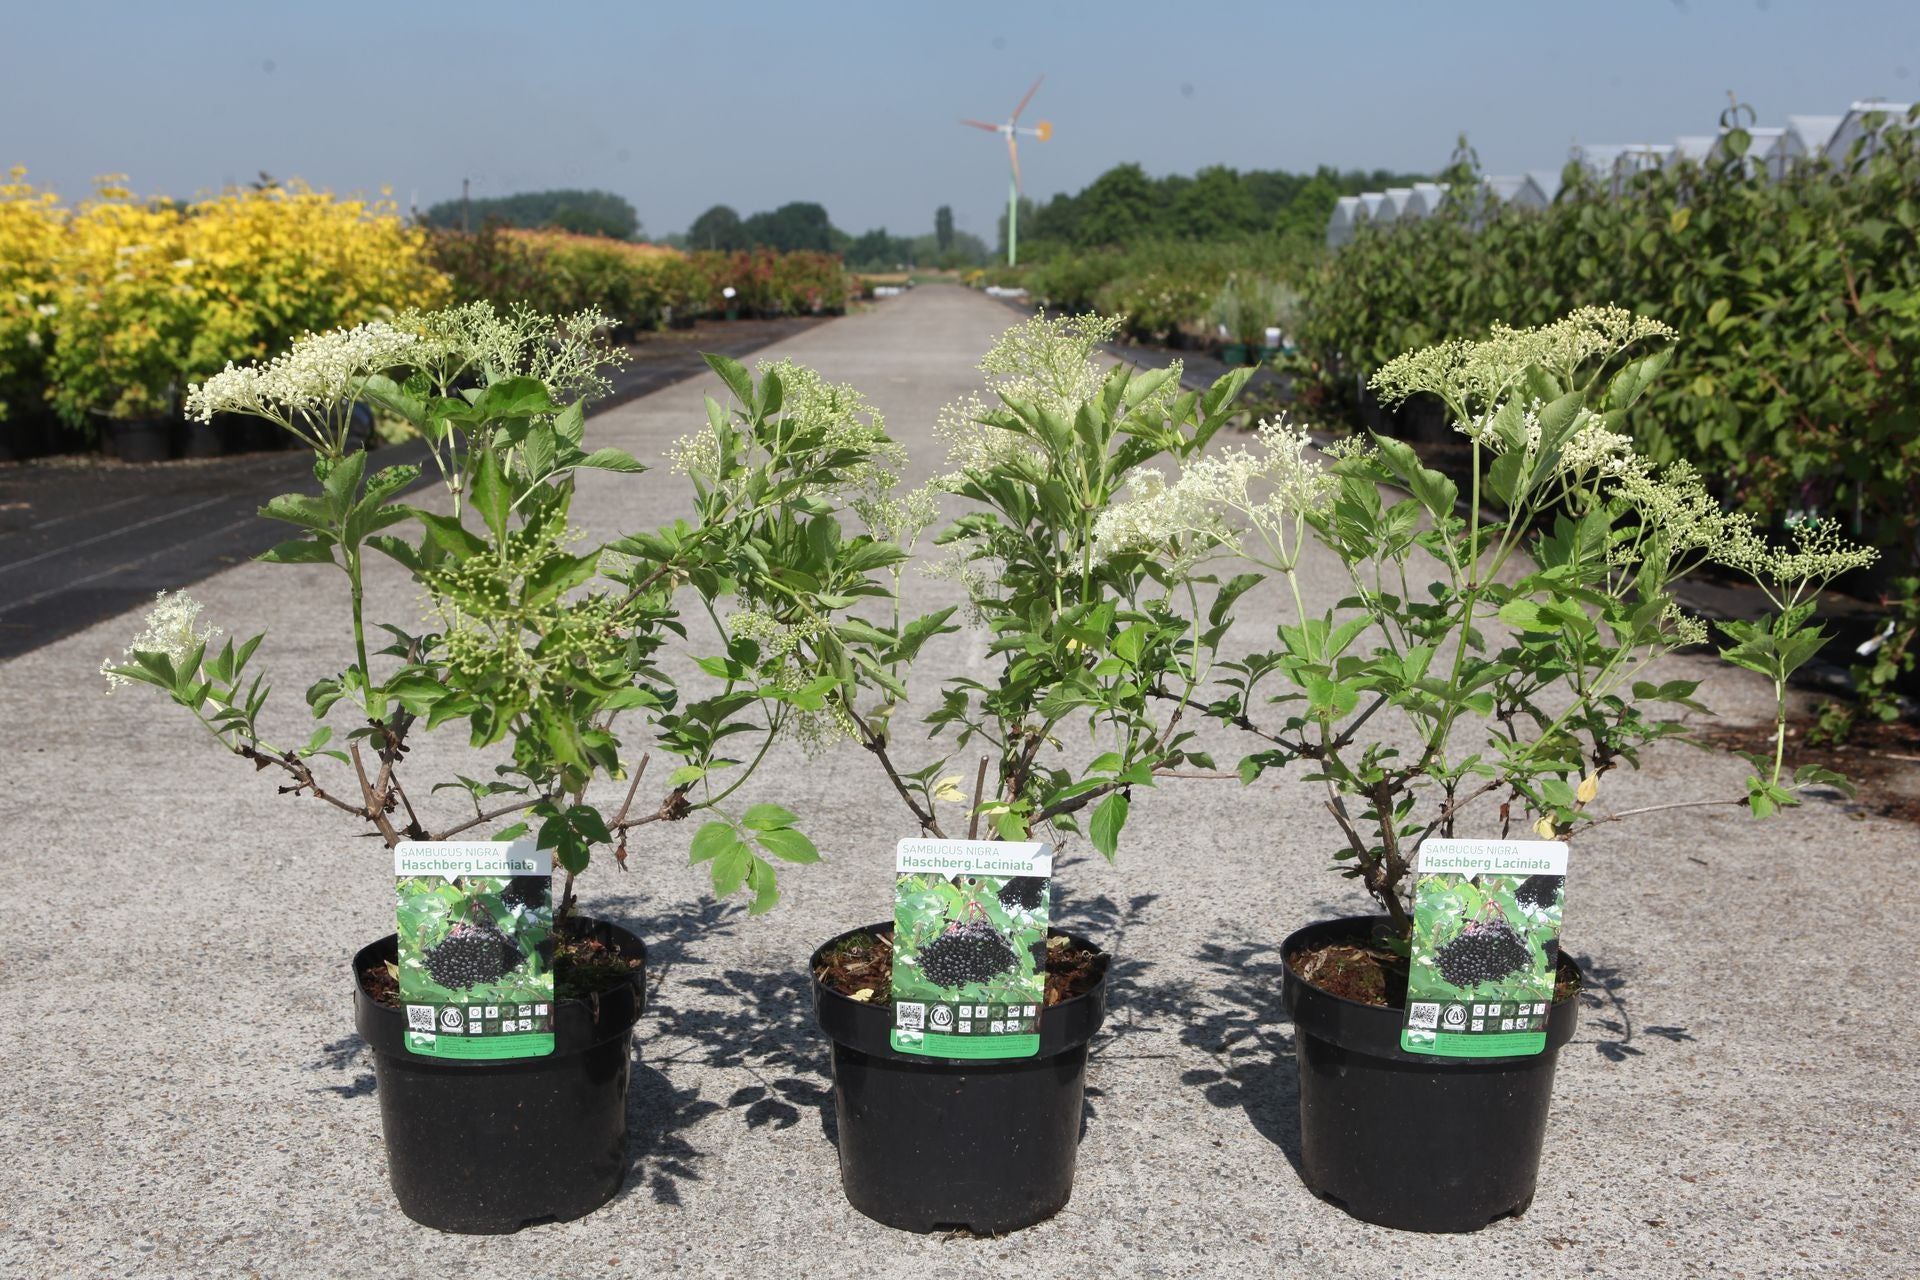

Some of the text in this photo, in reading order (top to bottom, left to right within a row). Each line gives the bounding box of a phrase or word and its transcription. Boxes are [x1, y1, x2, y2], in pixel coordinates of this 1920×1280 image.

[401, 847, 500, 857] SAMBUCUS NIGRA
[903, 844, 1000, 857] SAMBUCUS NIGRA
[1425, 844, 1519, 856] SAMBUCUS NIGRA
[402, 859, 534, 872] Haschberg Laciniata
[902, 856, 1034, 871] Haschberg Laciniata
[1425, 856, 1551, 870] Haschberg Laciniata
